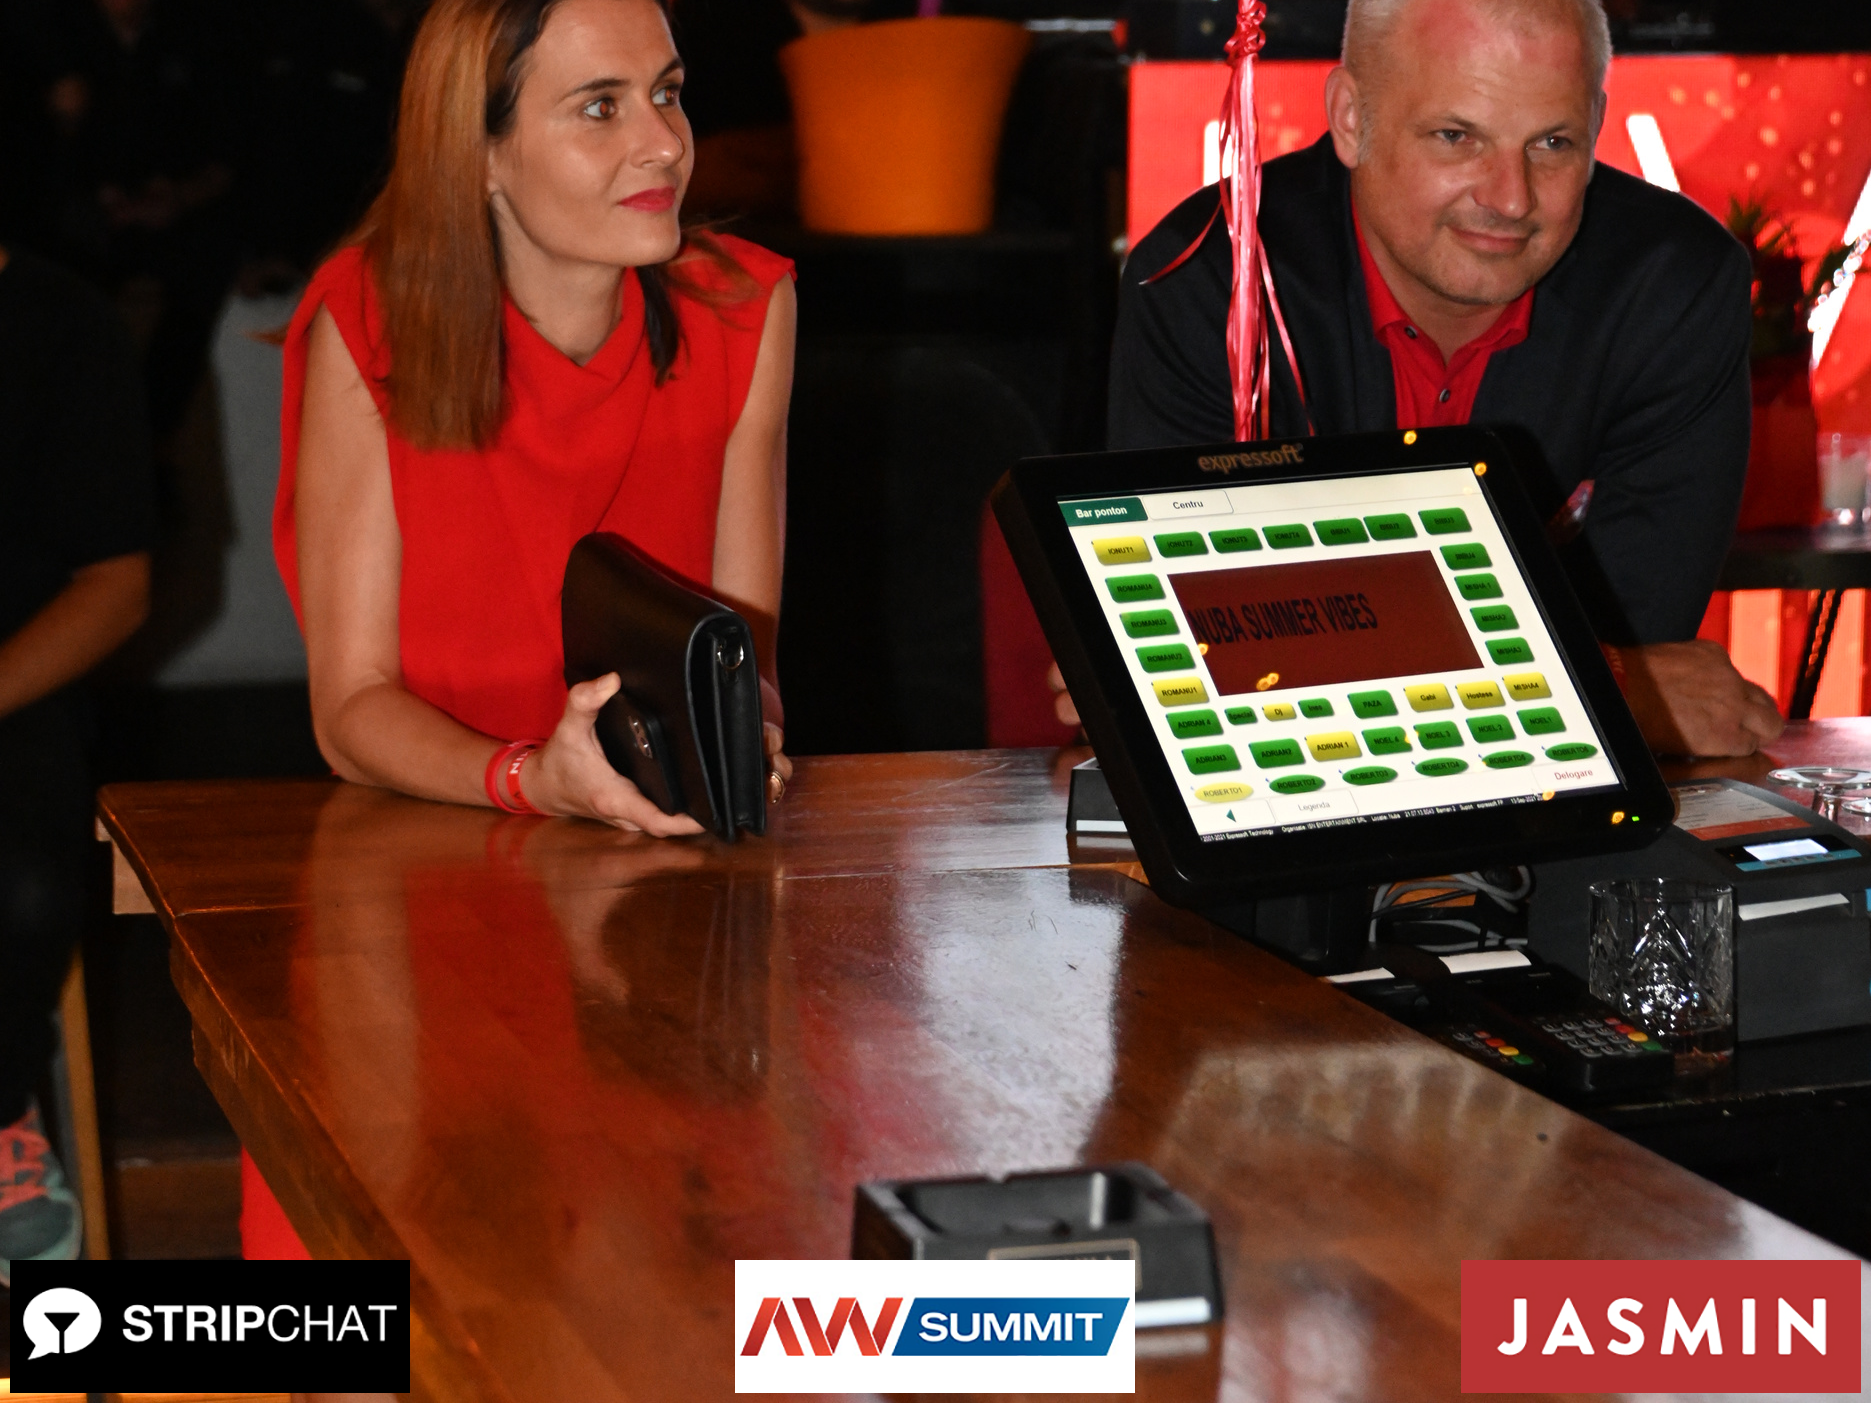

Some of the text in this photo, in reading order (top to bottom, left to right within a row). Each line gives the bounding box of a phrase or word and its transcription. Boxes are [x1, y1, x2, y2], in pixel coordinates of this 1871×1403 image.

[1198, 444, 1303, 474] expressoft
[1172, 499, 1204, 510] Centru
[1075, 505, 1128, 519] Bar ponton
[1222, 535, 1248, 544] IONUT3
[1274, 531, 1301, 540] IONUT4
[1167, 539, 1193, 549] IONUT2
[1107, 546, 1135, 555] IONUT1
[1116, 584, 1153, 593] ROMANU4
[1130, 618, 1167, 628] ROMANU3
[1188, 592, 1378, 646] NUBA SUMMER VIBES
[1146, 653, 1183, 663] ROMANU2
[1513, 682, 1540, 691] MISHA4
[1161, 687, 1198, 697] ROMANU1
[1420, 692, 1437, 701] Gabi
[1466, 691, 1493, 700] Hostess
[1362, 700, 1382, 708] PAZA
[1274, 708, 1284, 717] Dj
[1177, 718, 1212, 729] ADRIAN 4
[1478, 725, 1496, 734] NOEL
[1425, 731, 1445, 740] NOEL
[1373, 737, 1392, 746] NOEL
[1316, 742, 1343, 752] ADRIAN
[1261, 748, 1293, 758] ADRIAN2
[1195, 755, 1227, 764] ADRIAN3
[1422, 761, 1460, 772] ROBERTO4
[1350, 770, 1388, 780] ROBERTO3
[1554, 768, 1594, 781] Delogare
[1277, 778, 1317, 789] ROBERTO2
[1203, 787, 1243, 797] ROBERTO1
[1298, 801, 1331, 812] Legenda
